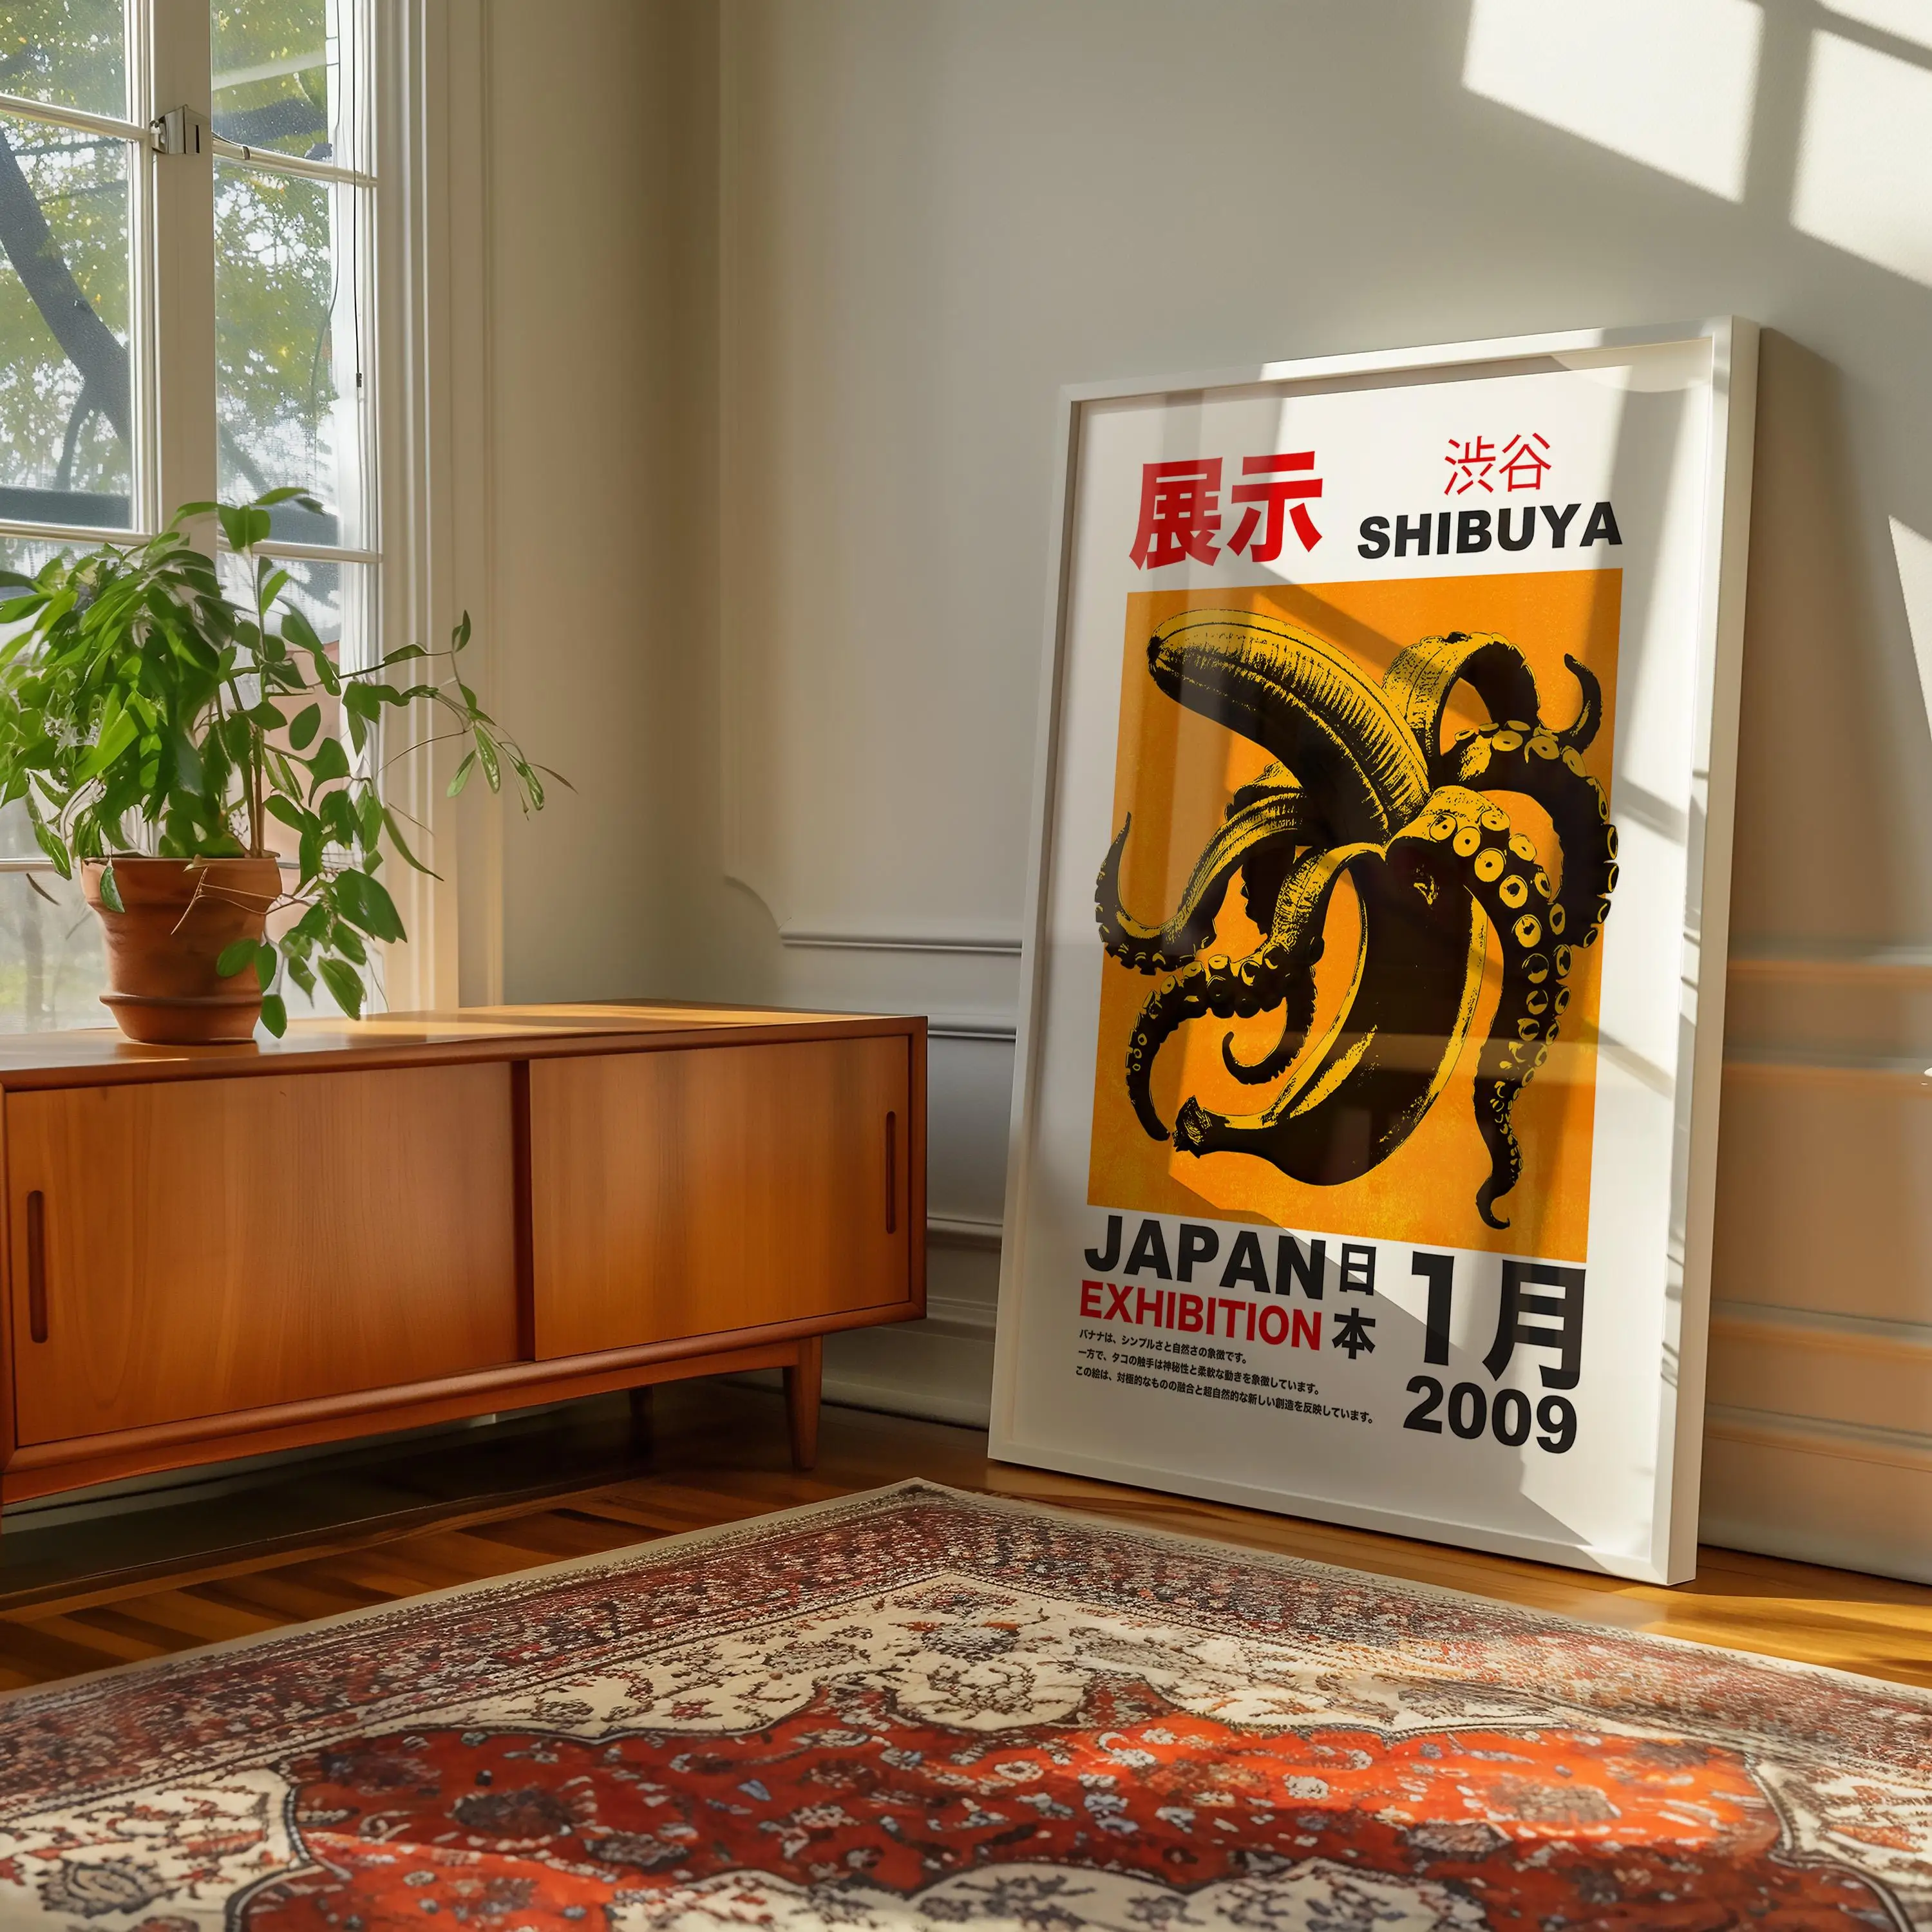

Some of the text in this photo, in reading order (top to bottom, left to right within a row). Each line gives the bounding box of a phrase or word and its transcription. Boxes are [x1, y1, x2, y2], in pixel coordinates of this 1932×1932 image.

[1444, 432, 1552, 495] 渋谷
[1129, 451, 1323, 570] 展示
[1357, 501, 1624, 559] SHIBUYA
[1084, 1215, 1327, 1300] JAPAN
[1079, 1280, 1322, 1350] EXHIBITION
[1331, 1242, 1377, 1360] 日本
[1410, 1251, 1587, 1391] 1月
[1403, 1375, 1578, 1454] 2009
